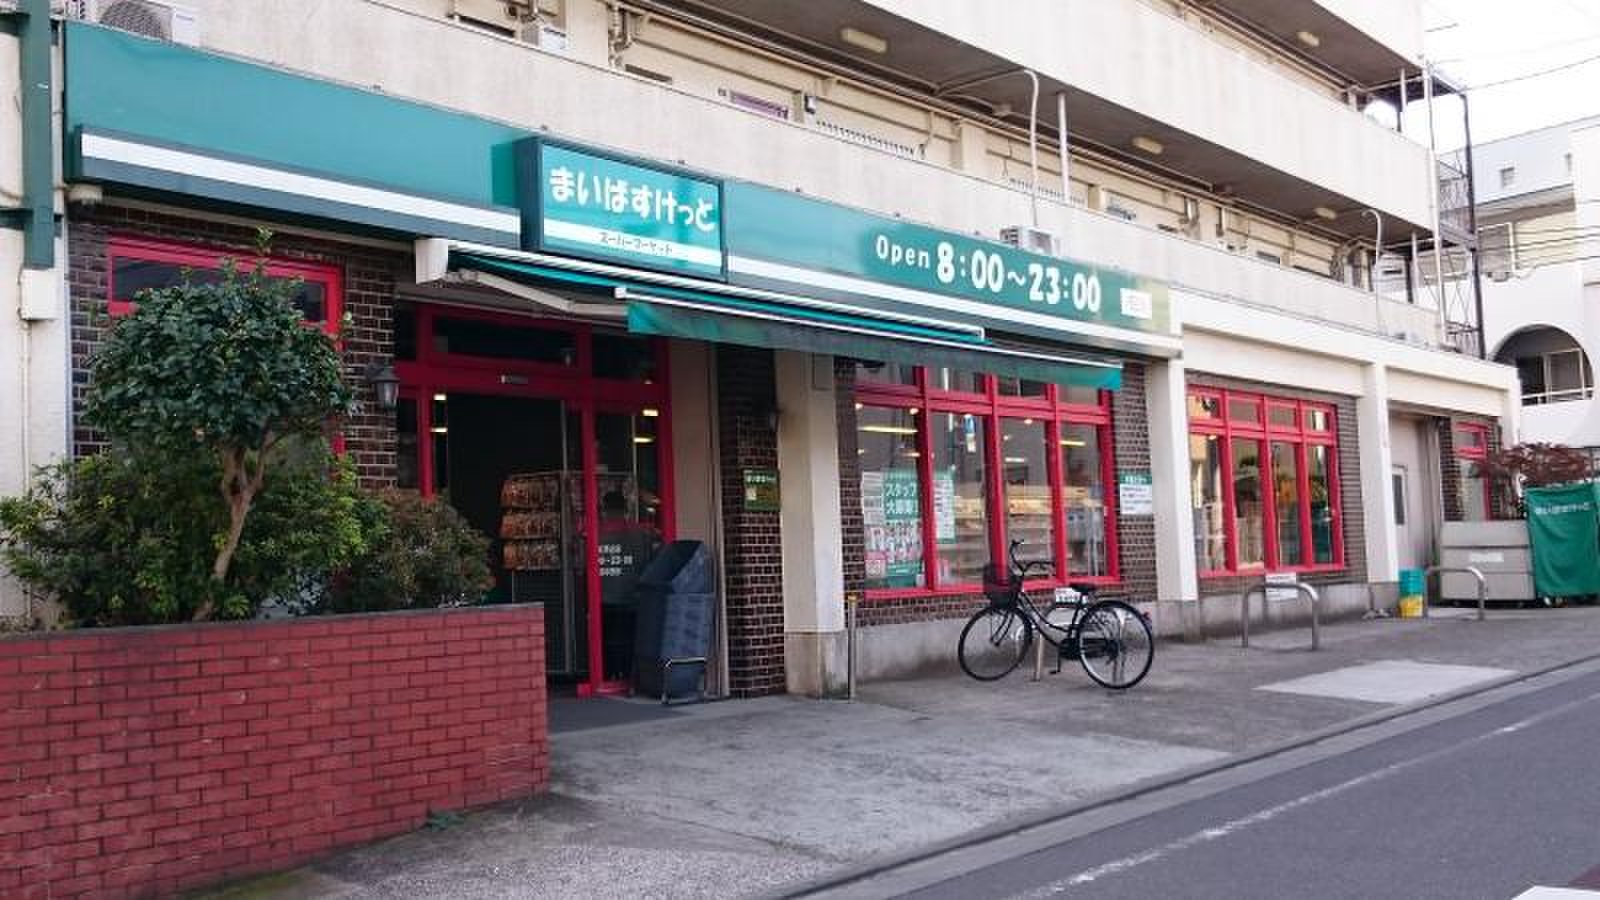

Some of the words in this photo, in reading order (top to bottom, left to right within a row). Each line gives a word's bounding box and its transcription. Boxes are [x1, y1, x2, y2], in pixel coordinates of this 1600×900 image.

[549, 167, 716, 231] まいばすけっと
[875, 235, 930, 269] Open
